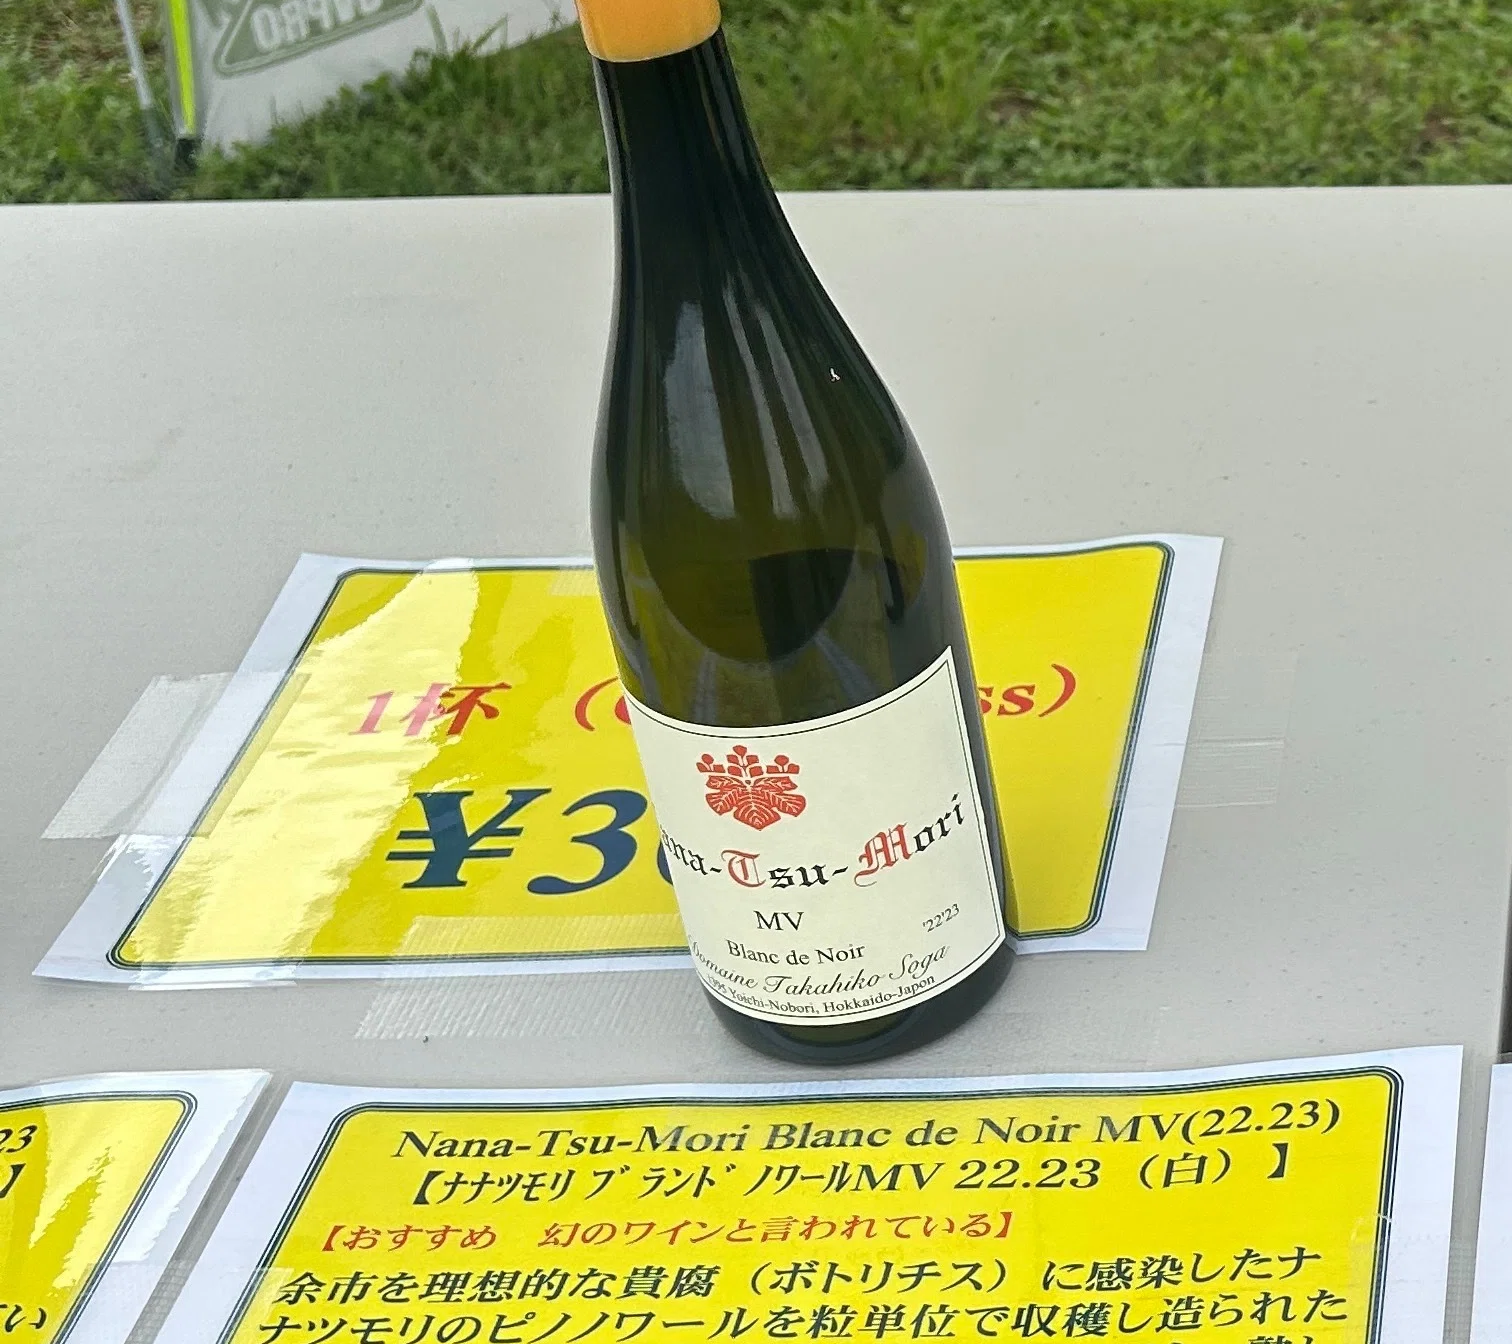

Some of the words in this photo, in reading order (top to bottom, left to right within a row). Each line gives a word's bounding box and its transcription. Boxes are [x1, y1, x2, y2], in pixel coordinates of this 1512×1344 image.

[348, 681, 512, 736] 1杯
[385, 787, 675, 897] ¥3
[753, 911, 804, 931] MV
[726, 939, 780, 965] Blanc
[785, 949, 810, 965] de
[815, 943, 866, 965] Noir
[763, 968, 886, 996] Takahiko
[888, 945, 949, 981] Soga
[392, 1123, 747, 1159] Nana-Tsu-Mori
[760, 1121, 892, 1151] Blanc
[904, 1119, 958, 1147] de
[972, 1114, 1084, 1145] Noir
[1094, 1097, 1341, 1145] MV(22.23)
[0, 1303, 47, 1333] い
